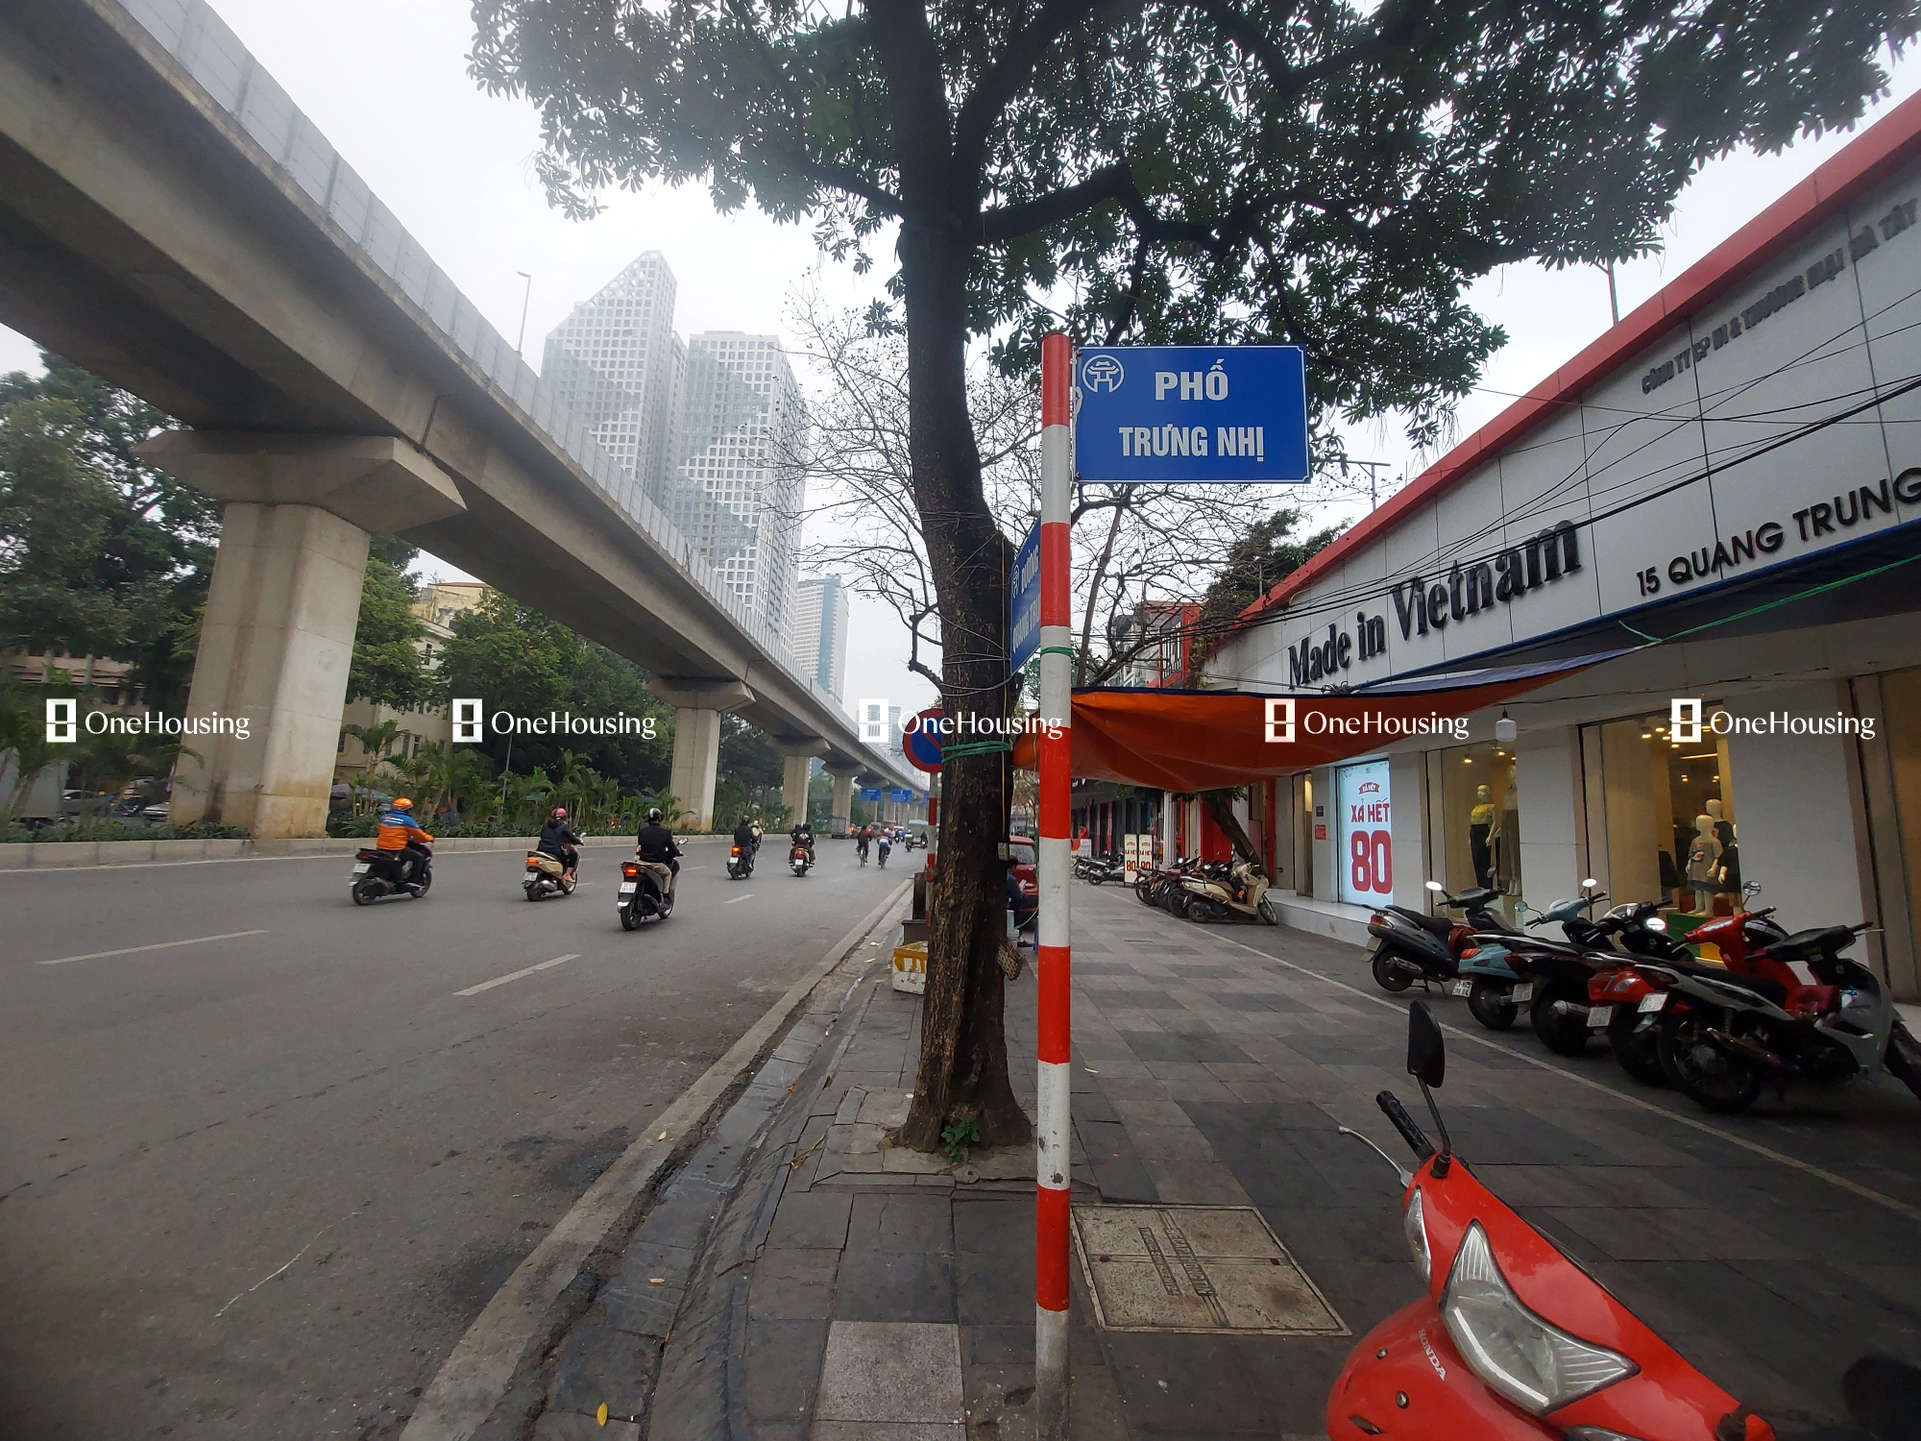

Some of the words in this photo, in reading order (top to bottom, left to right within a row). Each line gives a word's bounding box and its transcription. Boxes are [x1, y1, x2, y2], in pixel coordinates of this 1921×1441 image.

[1674, 347, 1691, 373] TY
[1730, 316, 1742, 338] &
[1155, 358, 1229, 401] PHỐ
[1118, 423, 1208, 457] TRƯNG
[1217, 426, 1265, 462] NHỊ
[1636, 566, 1661, 596] 15
[1668, 522, 1784, 585] QUANG
[1792, 467, 1921, 541] TRUNG
[1288, 622, 1352, 690] Made
[1357, 611, 1386, 661] in
[1390, 519, 1582, 641] Vietnam
[1350, 798, 1365, 823] XẢ
[1367, 797, 1390, 823] HẾT
[1351, 830, 1393, 894] 80
[1417, 1327, 1446, 1382] HONDA
